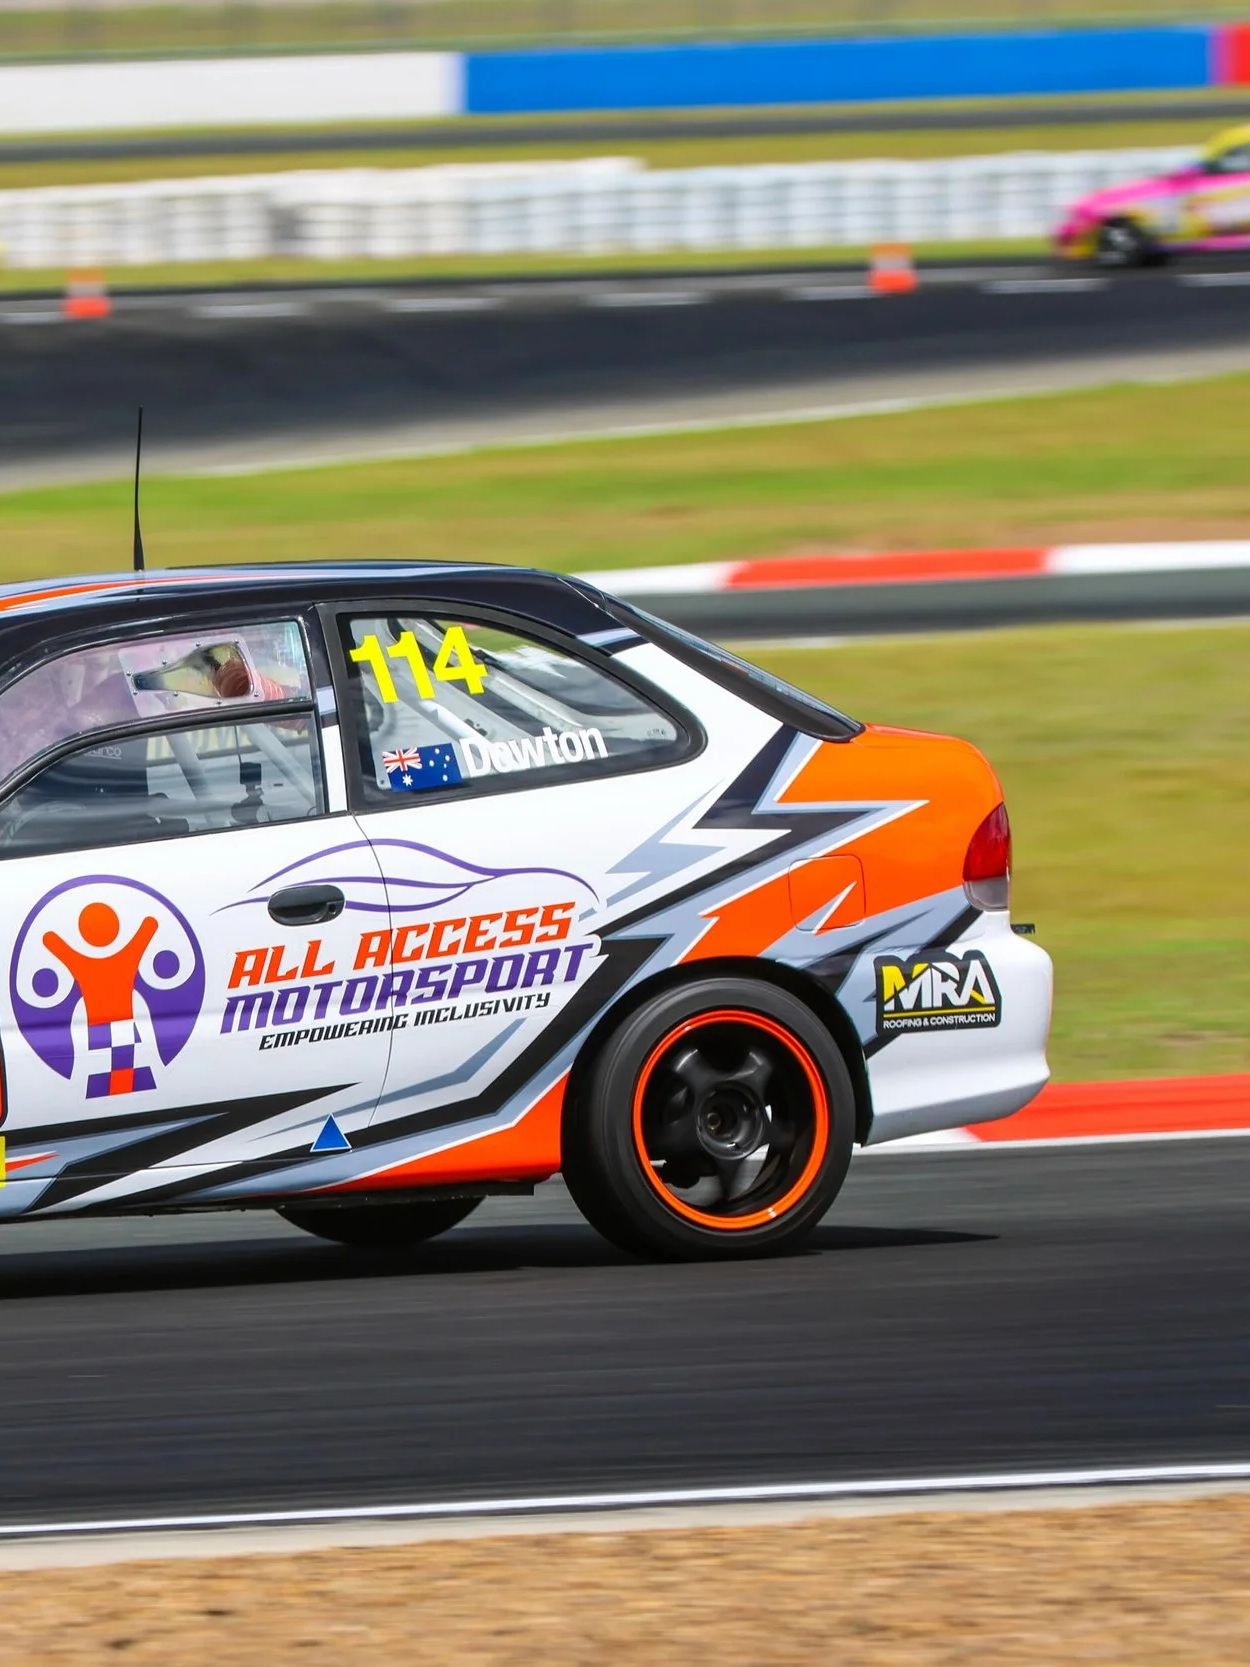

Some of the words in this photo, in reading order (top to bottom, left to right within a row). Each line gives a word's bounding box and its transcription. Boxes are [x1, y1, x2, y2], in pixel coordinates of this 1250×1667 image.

[349, 626, 488, 704] 114
[460, 726, 609, 777] Dawton
[227, 940, 336, 990] ALL
[352, 901, 576, 970] ACCESS
[219, 943, 594, 1034] MOTORSPORT
[881, 959, 996, 1012] MRA
[258, 1012, 410, 1051] EMPOWERING
[413, 992, 551, 1028] INCLUSIVITY
[883, 1017, 922, 1029] ROOFING
[923, 1017, 930, 1026] &
[930, 1013, 996, 1026] CONSTRUCTION
